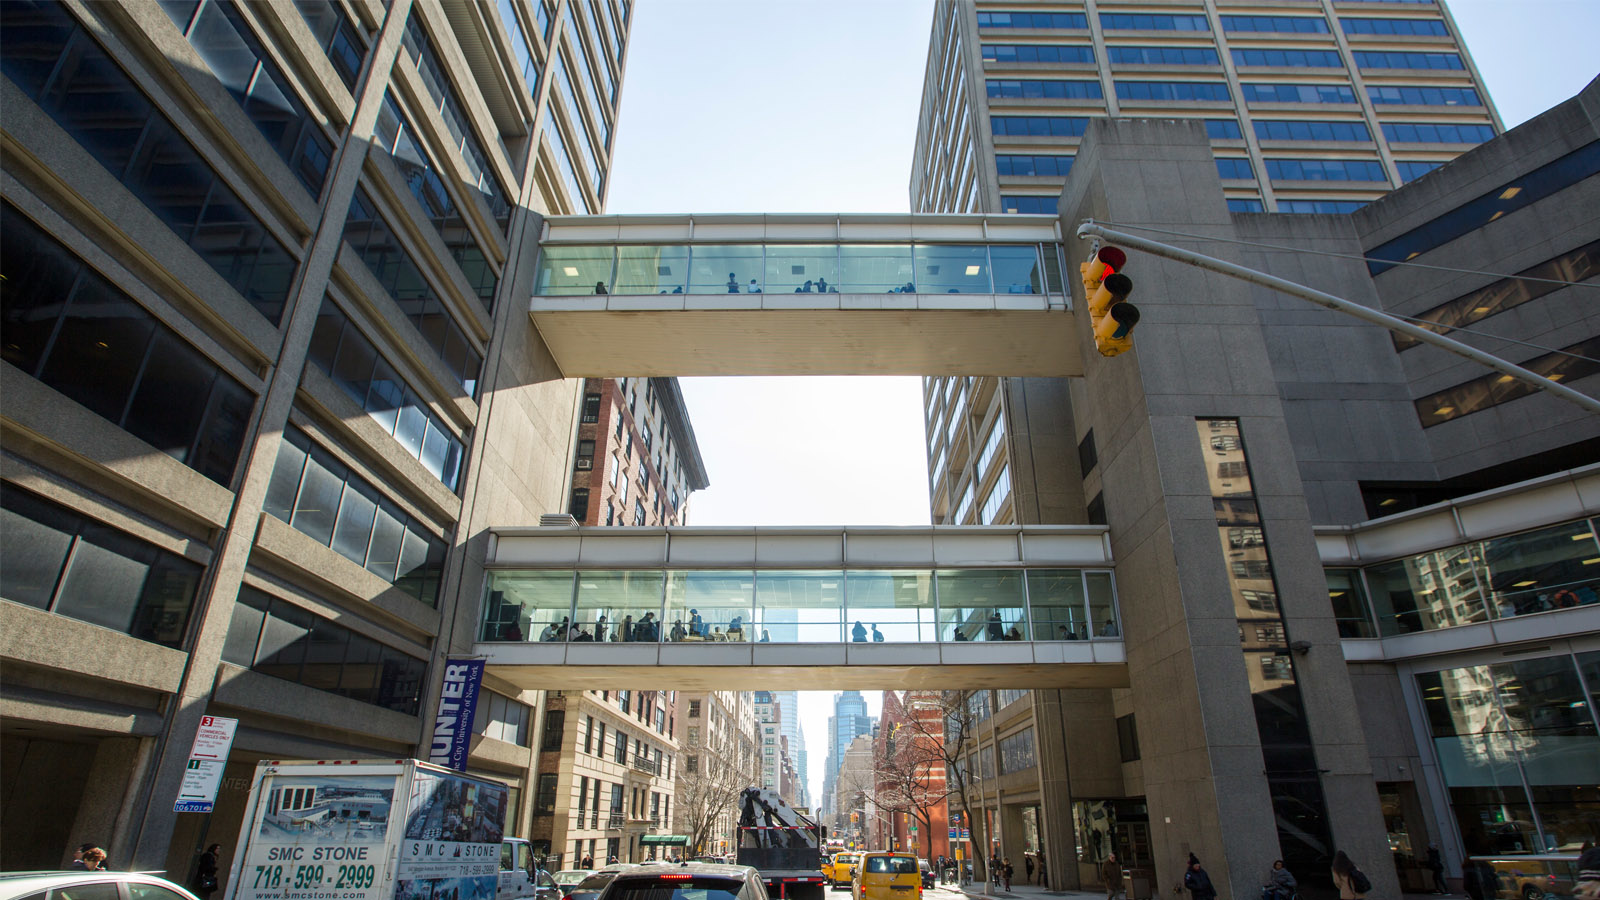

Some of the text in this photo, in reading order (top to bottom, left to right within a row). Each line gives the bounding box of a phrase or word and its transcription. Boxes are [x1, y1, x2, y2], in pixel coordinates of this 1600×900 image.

[469, 665, 479, 681] York
[465, 699, 472, 707] of
[204, 717, 212, 726] 3
[456, 706, 471, 743] University
[454, 745, 465, 761] City
[222, 777, 249, 790] NTER
[268, 847, 368, 860] SMC STONE
[465, 845, 494, 857] STONE
[255, 891, 366, 900] www.smcstone.com
